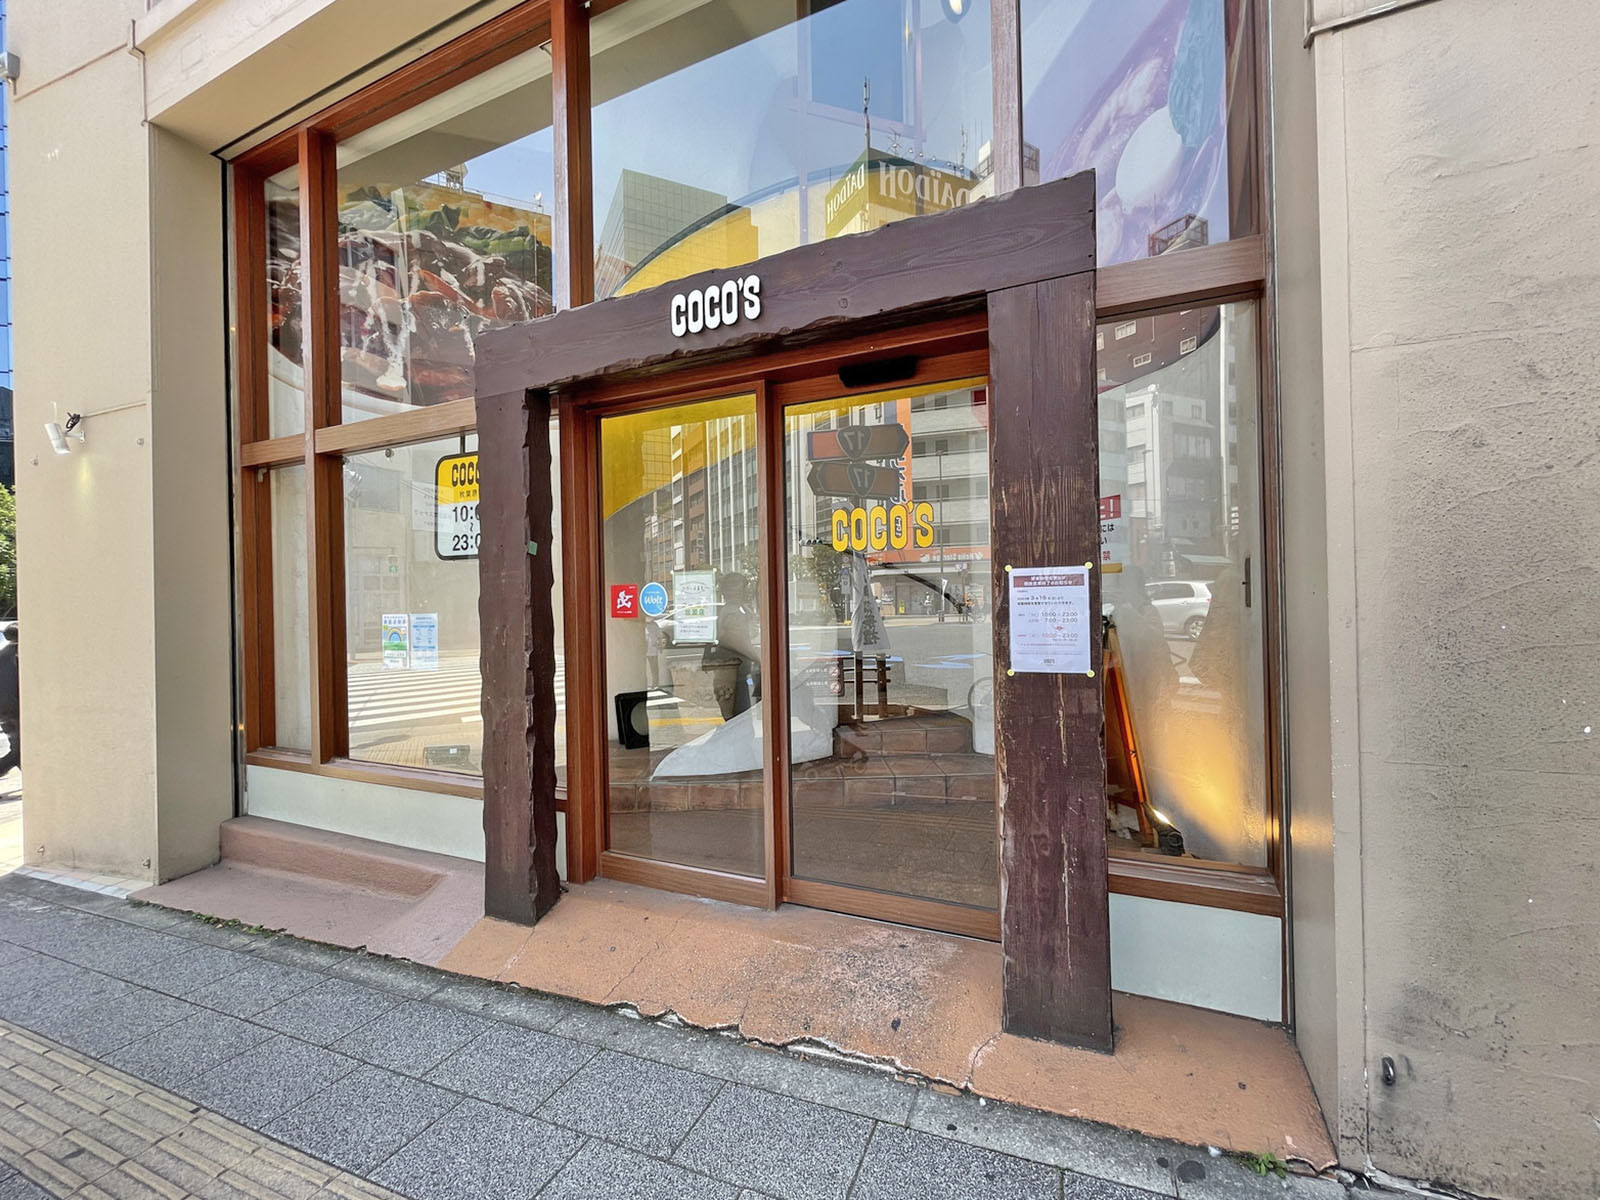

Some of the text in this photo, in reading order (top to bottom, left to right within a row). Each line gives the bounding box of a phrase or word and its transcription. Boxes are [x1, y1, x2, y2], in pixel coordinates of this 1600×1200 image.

[671, 274, 761, 337] COCO'S
[831, 499, 934, 552] COCO'S
[644, 595, 664, 606] Wolt
